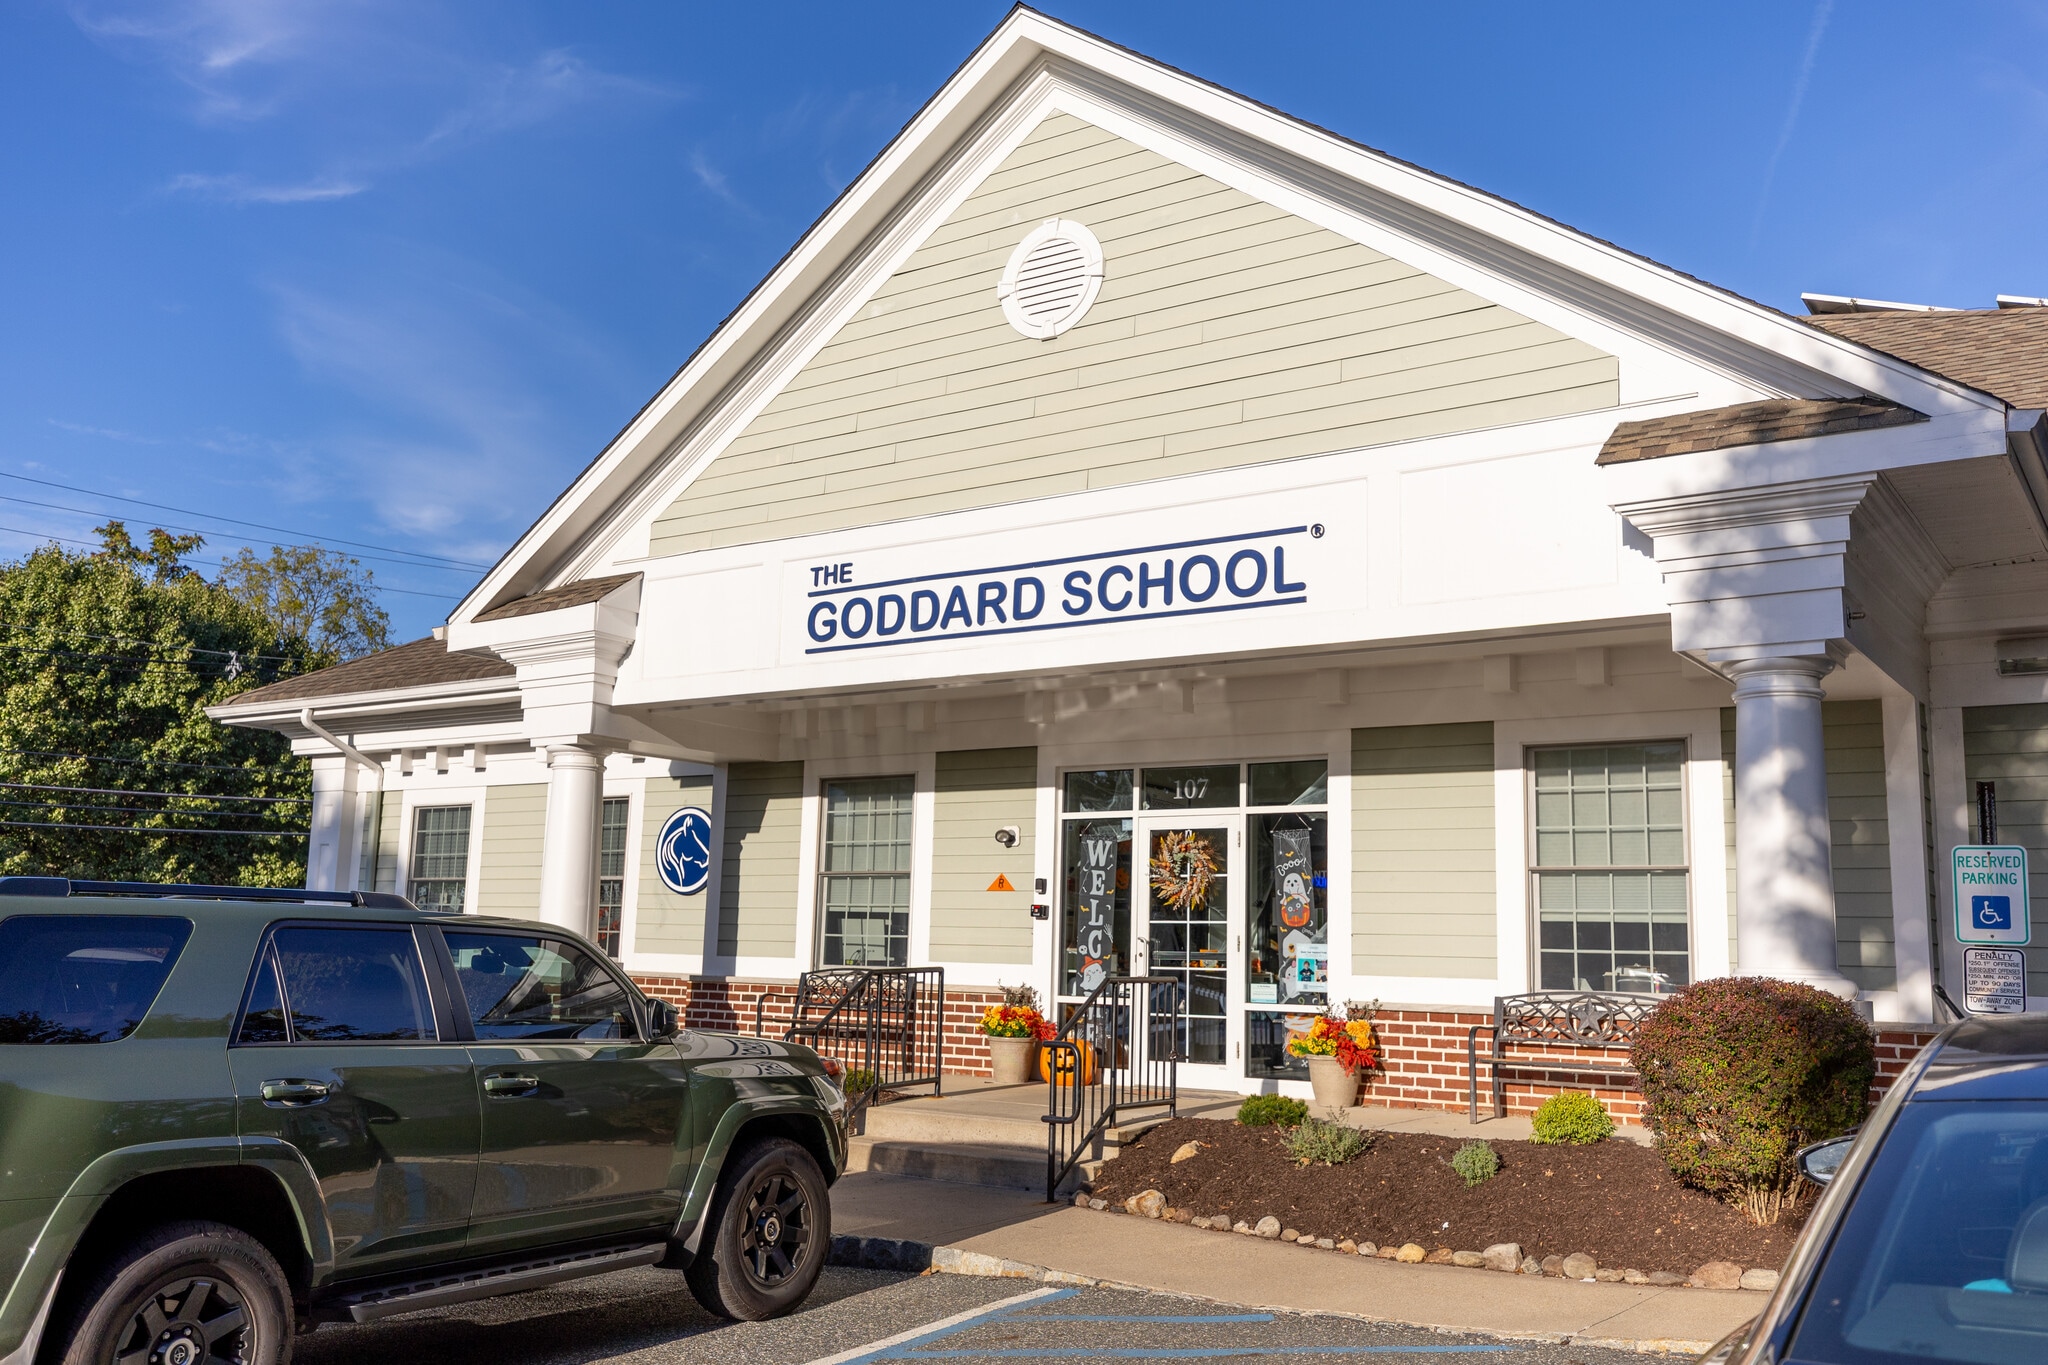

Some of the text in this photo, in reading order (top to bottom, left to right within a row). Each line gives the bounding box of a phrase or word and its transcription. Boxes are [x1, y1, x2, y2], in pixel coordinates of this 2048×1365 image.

[810, 562, 853, 587] THE
[807, 545, 1307, 643] GODDARD SCHOOL
[1173, 777, 1209, 800] 107
[1957, 855, 2021, 868] RESERVED
[1962, 872, 2018, 885] PARKING
[1974, 952, 2012, 960] PENALTY
